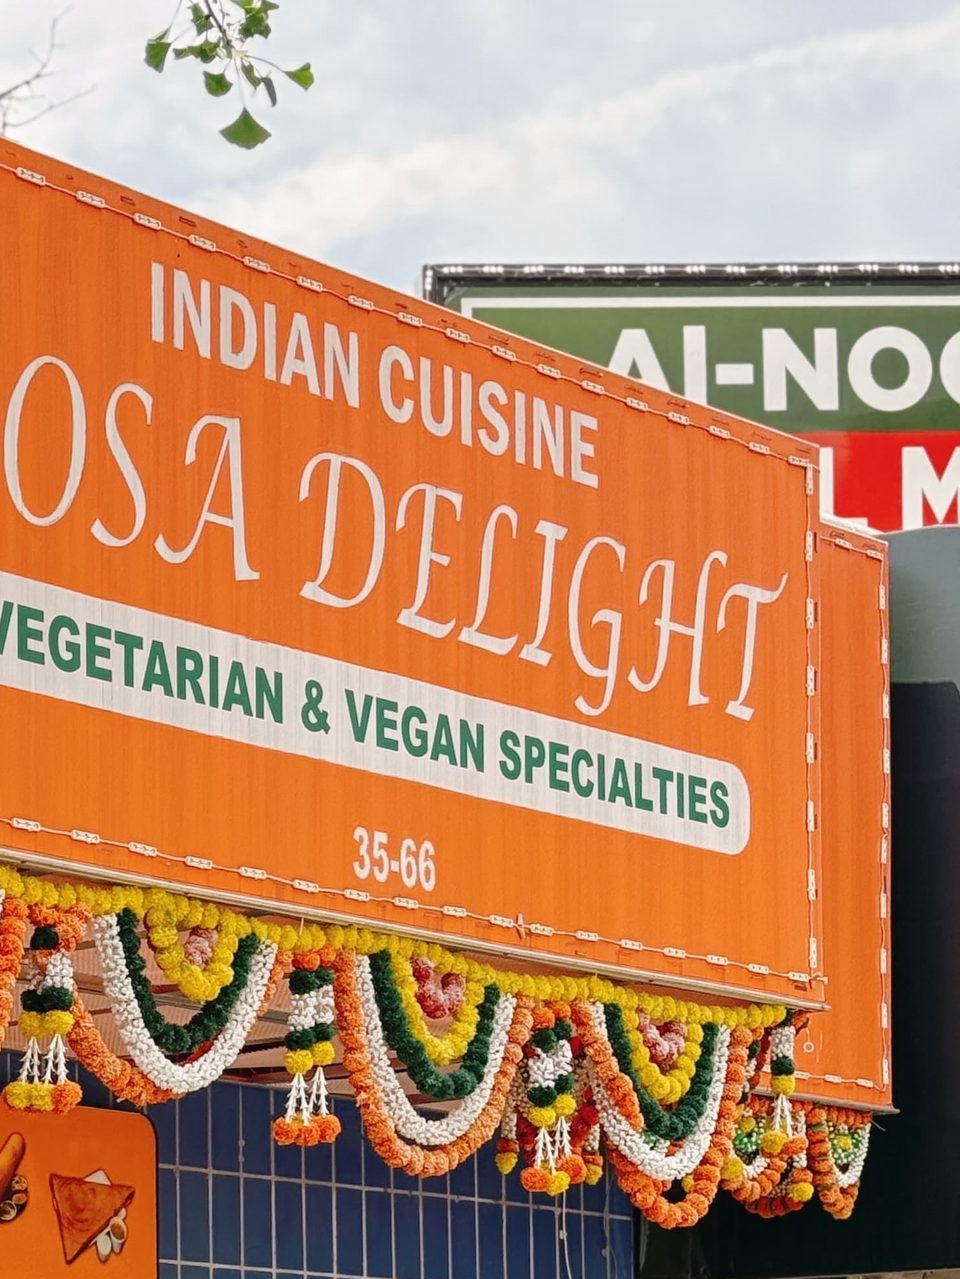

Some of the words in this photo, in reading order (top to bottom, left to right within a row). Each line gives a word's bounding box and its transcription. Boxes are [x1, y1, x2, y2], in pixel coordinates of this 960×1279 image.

[151, 262, 360, 408] INDIAN
[380, 345, 599, 488] CUISINE
[299, 451, 788, 721] DELIGHT
[300, 680, 331, 732] &
[345, 688, 485, 774] VEGAN
[499, 729, 731, 829] SPECIALTIES
[352, 825, 437, 892] 35-66
